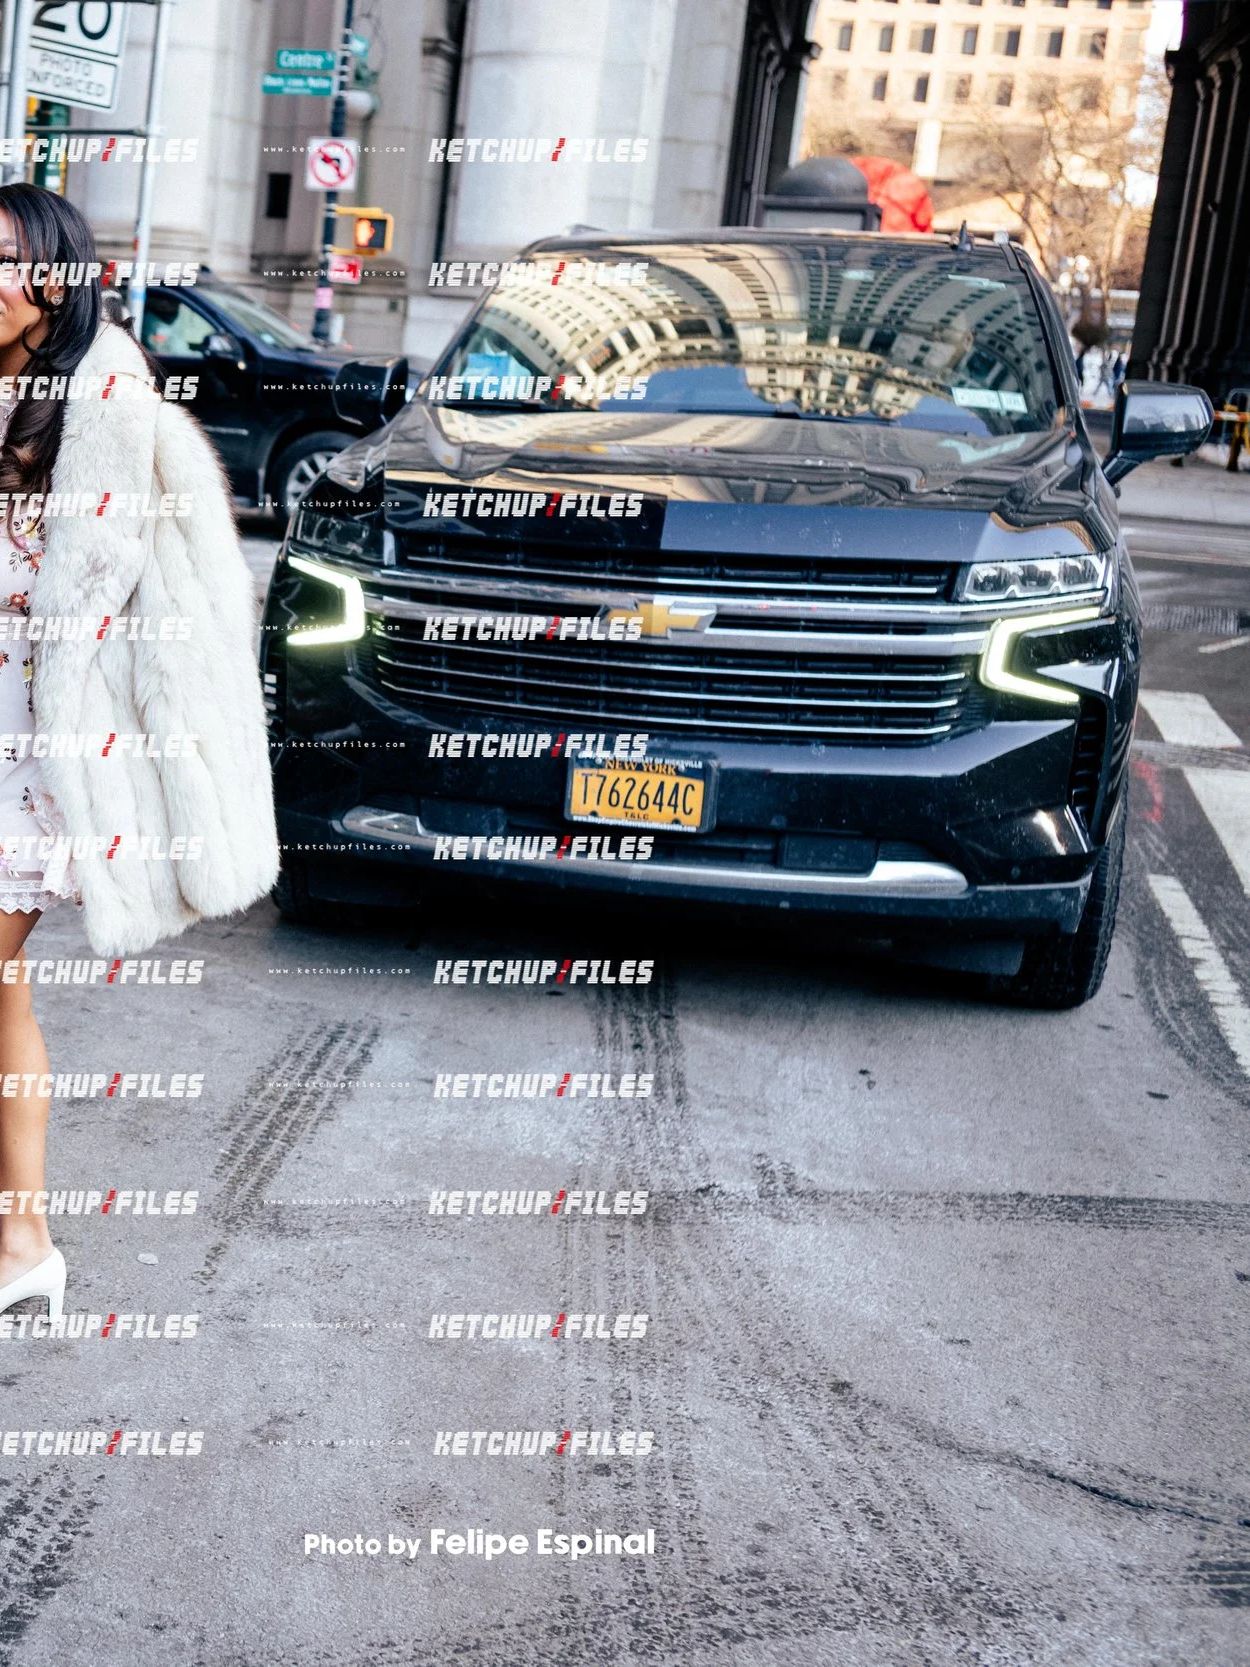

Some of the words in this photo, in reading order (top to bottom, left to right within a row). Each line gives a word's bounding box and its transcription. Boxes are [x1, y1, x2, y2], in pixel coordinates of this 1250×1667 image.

[39, 53, 94, 77] PHOTO
[29, 68, 105, 97] NFORCED
[605, 758, 638, 771] NEW
[641, 761, 677, 775] YORK
[581, 773, 696, 816] T762644C
